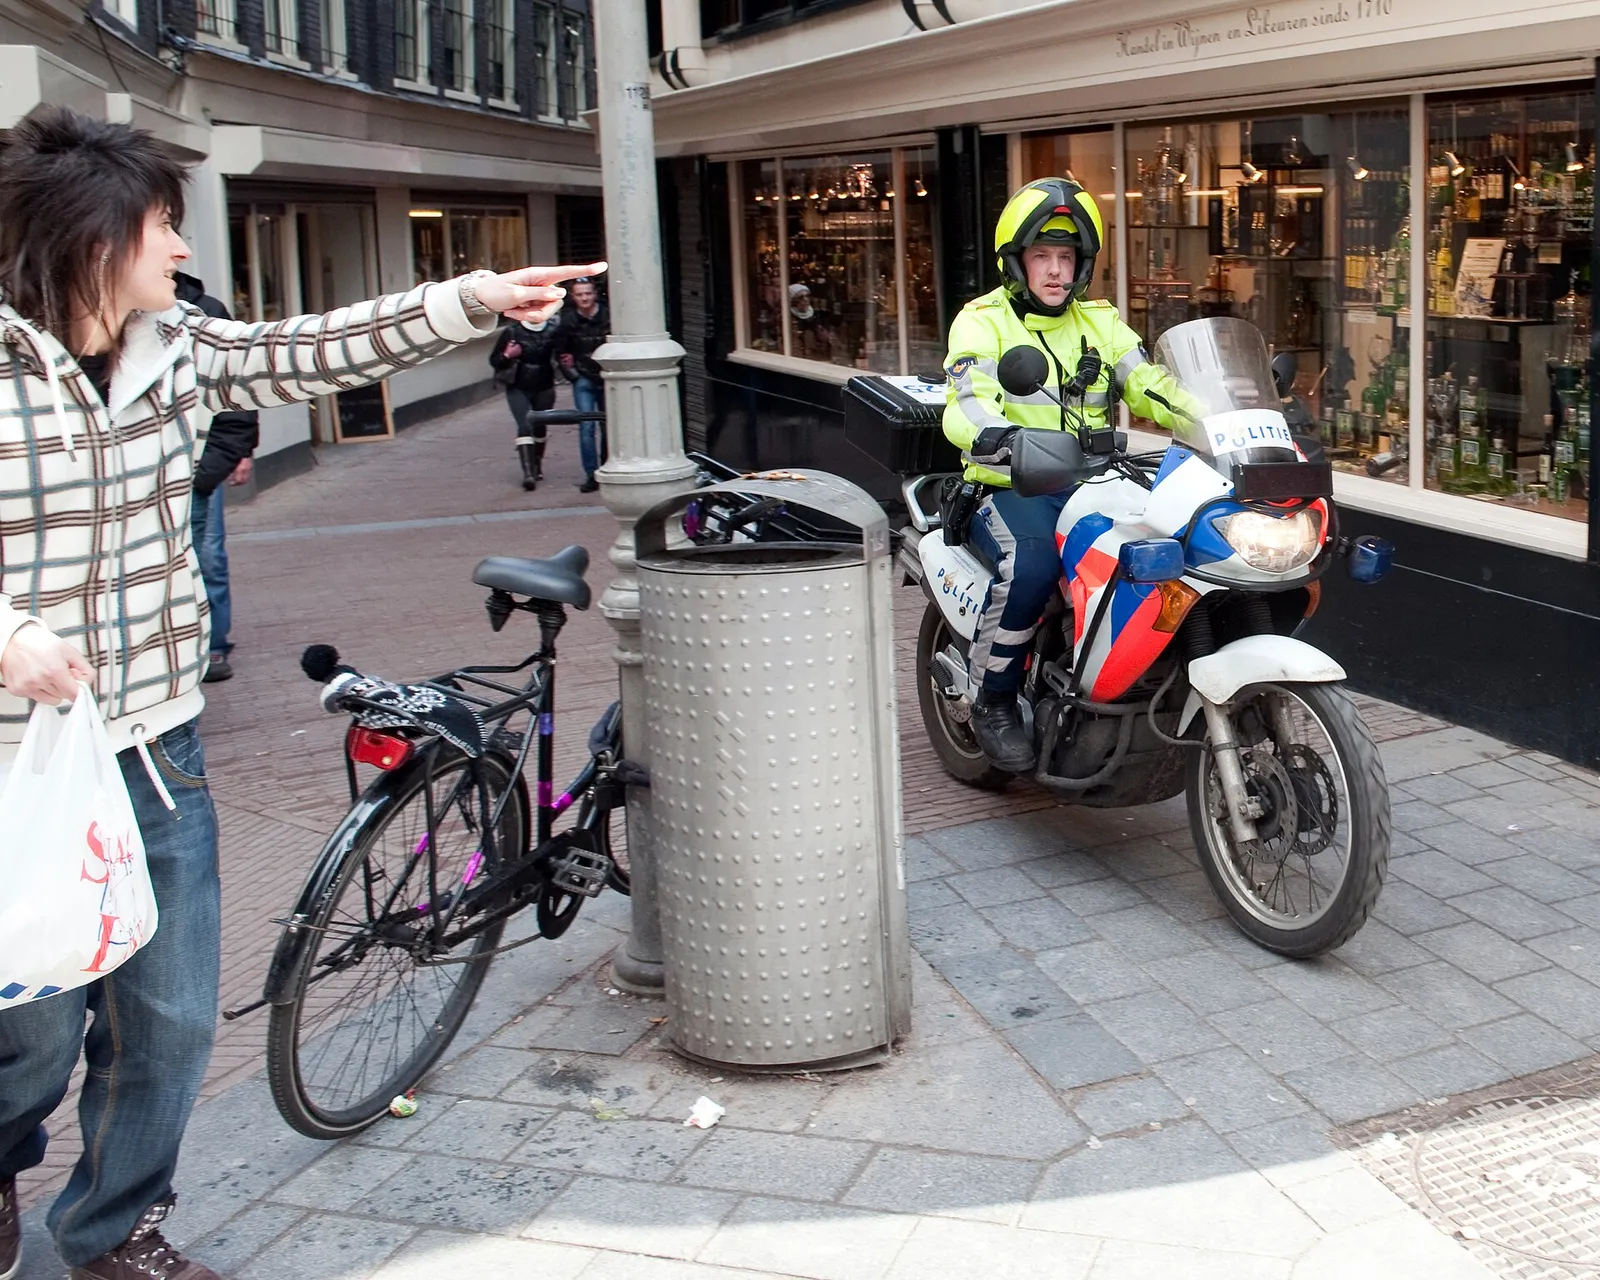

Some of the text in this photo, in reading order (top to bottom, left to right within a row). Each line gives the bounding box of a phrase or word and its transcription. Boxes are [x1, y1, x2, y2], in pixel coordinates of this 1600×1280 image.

[1116, 29, 1160, 57] Handel
[1162, 34, 1175, 50] in
[1173, 19, 1221, 58] Wijnen
[1226, 28, 1242, 40] en
[1244, 7, 1308, 37] Likeuren
[1311, 2, 1350, 27] sinds
[1214, 426, 1291, 448] POLITIE
[937, 567, 979, 615] POLITI
